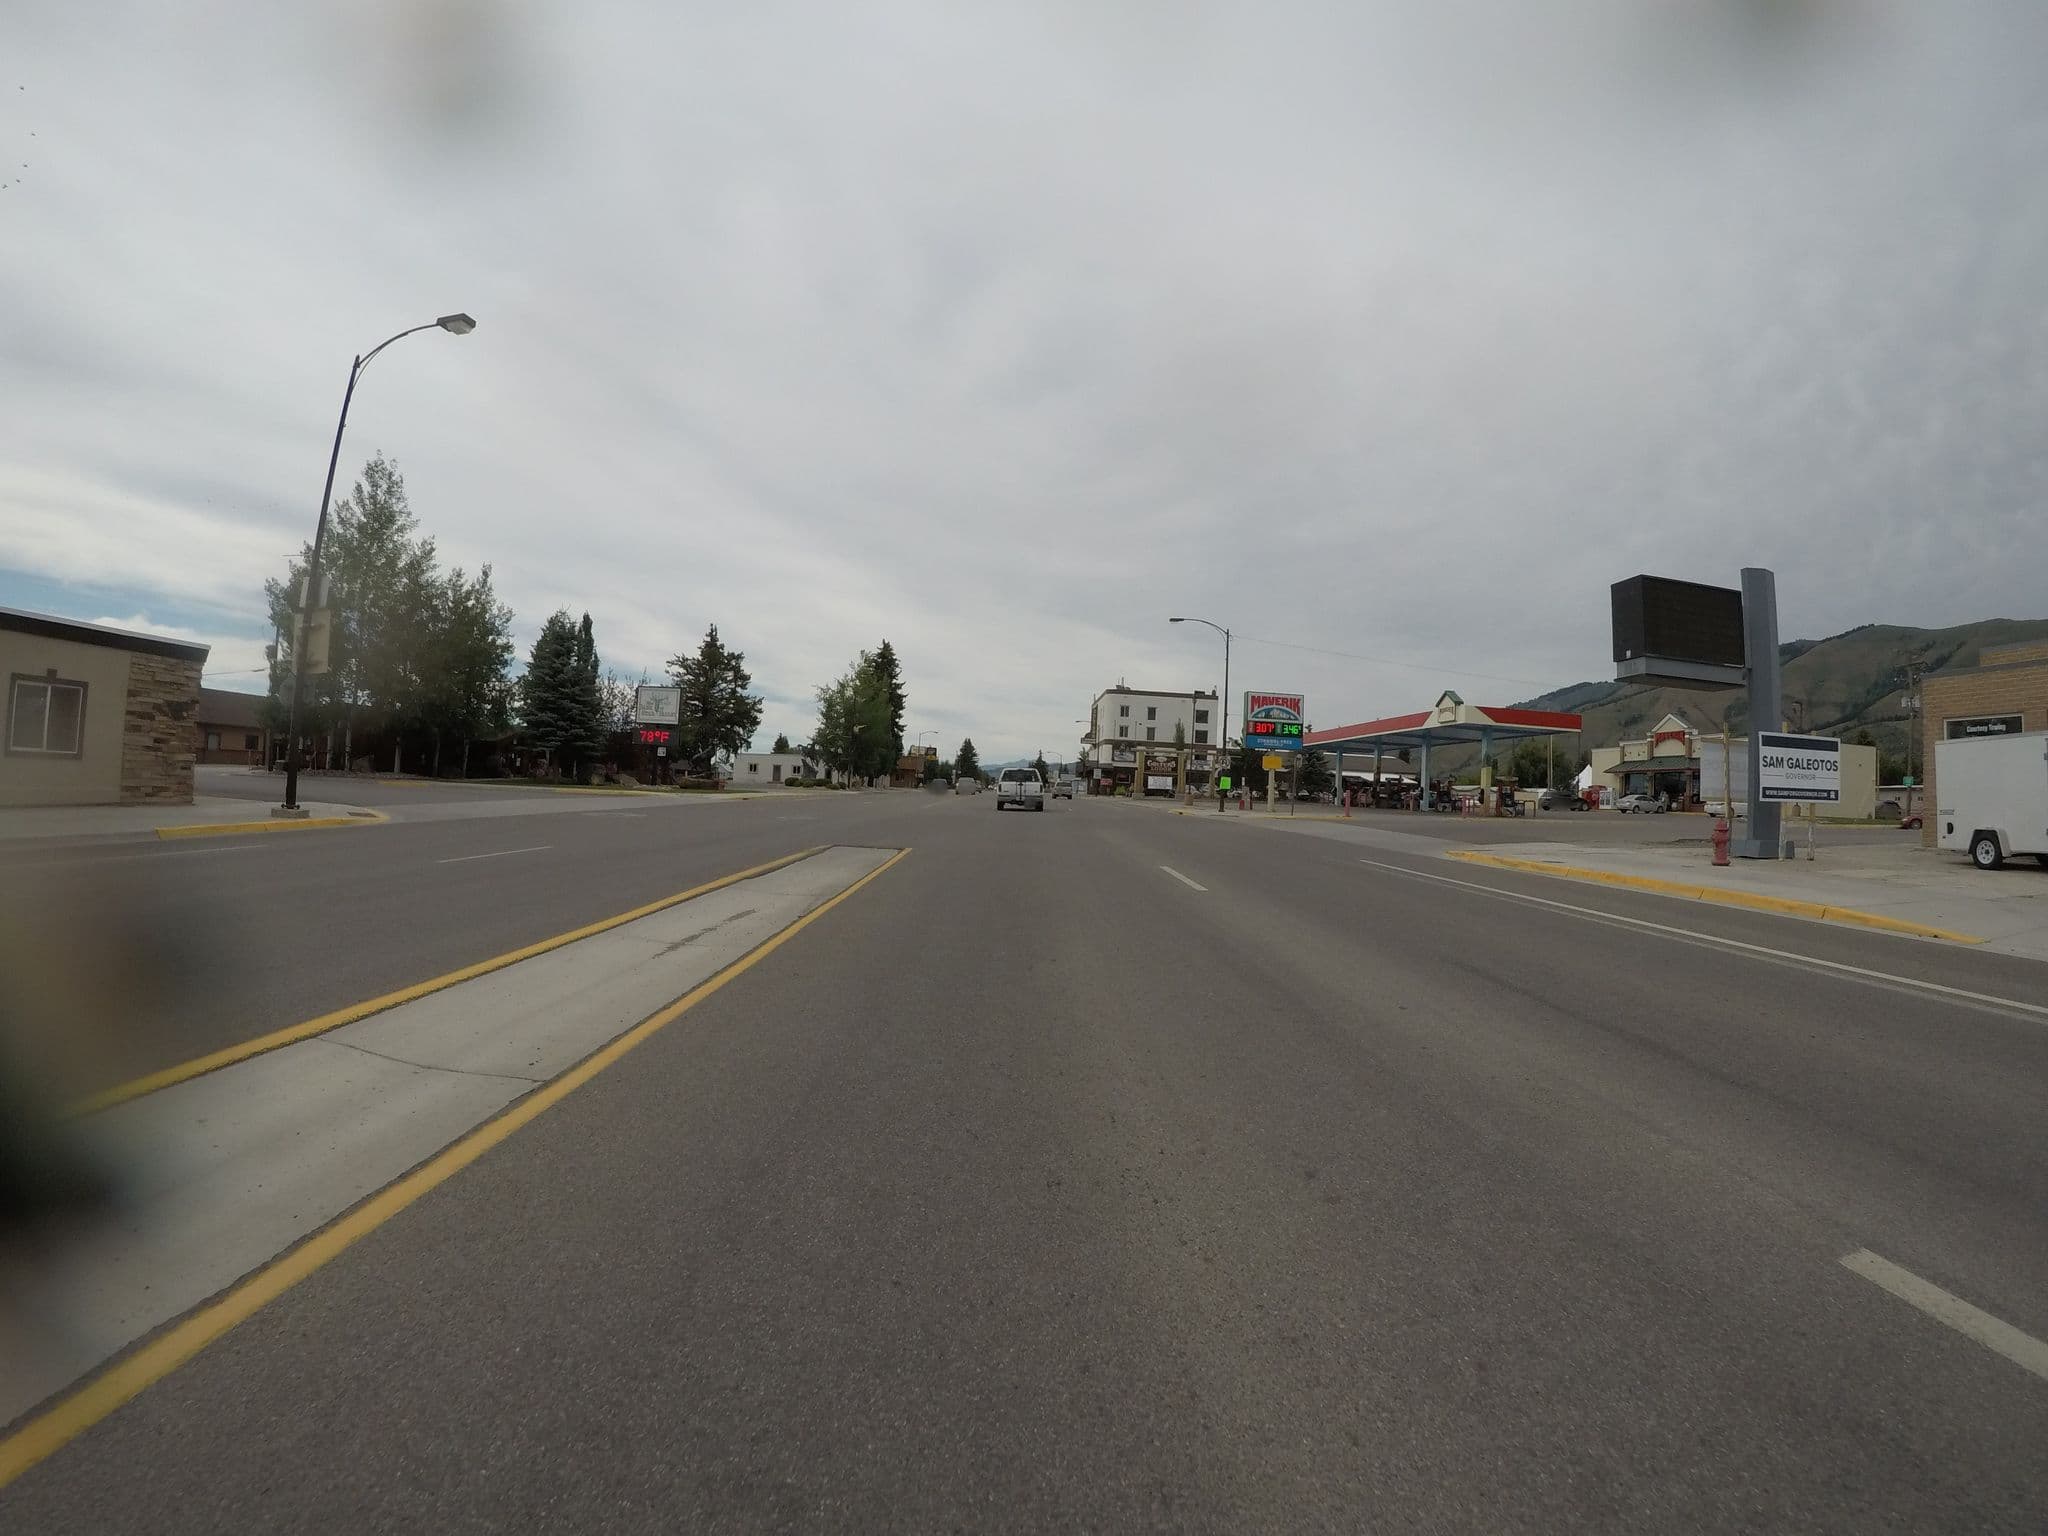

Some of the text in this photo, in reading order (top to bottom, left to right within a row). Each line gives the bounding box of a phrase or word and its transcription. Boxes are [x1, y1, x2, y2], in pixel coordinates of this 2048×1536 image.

[1251, 695, 1301, 717] MAVERIK
[1762, 755, 1839, 772] SAM GALEOTOS
[1785, 772, 1816, 780] GOVERNOR
